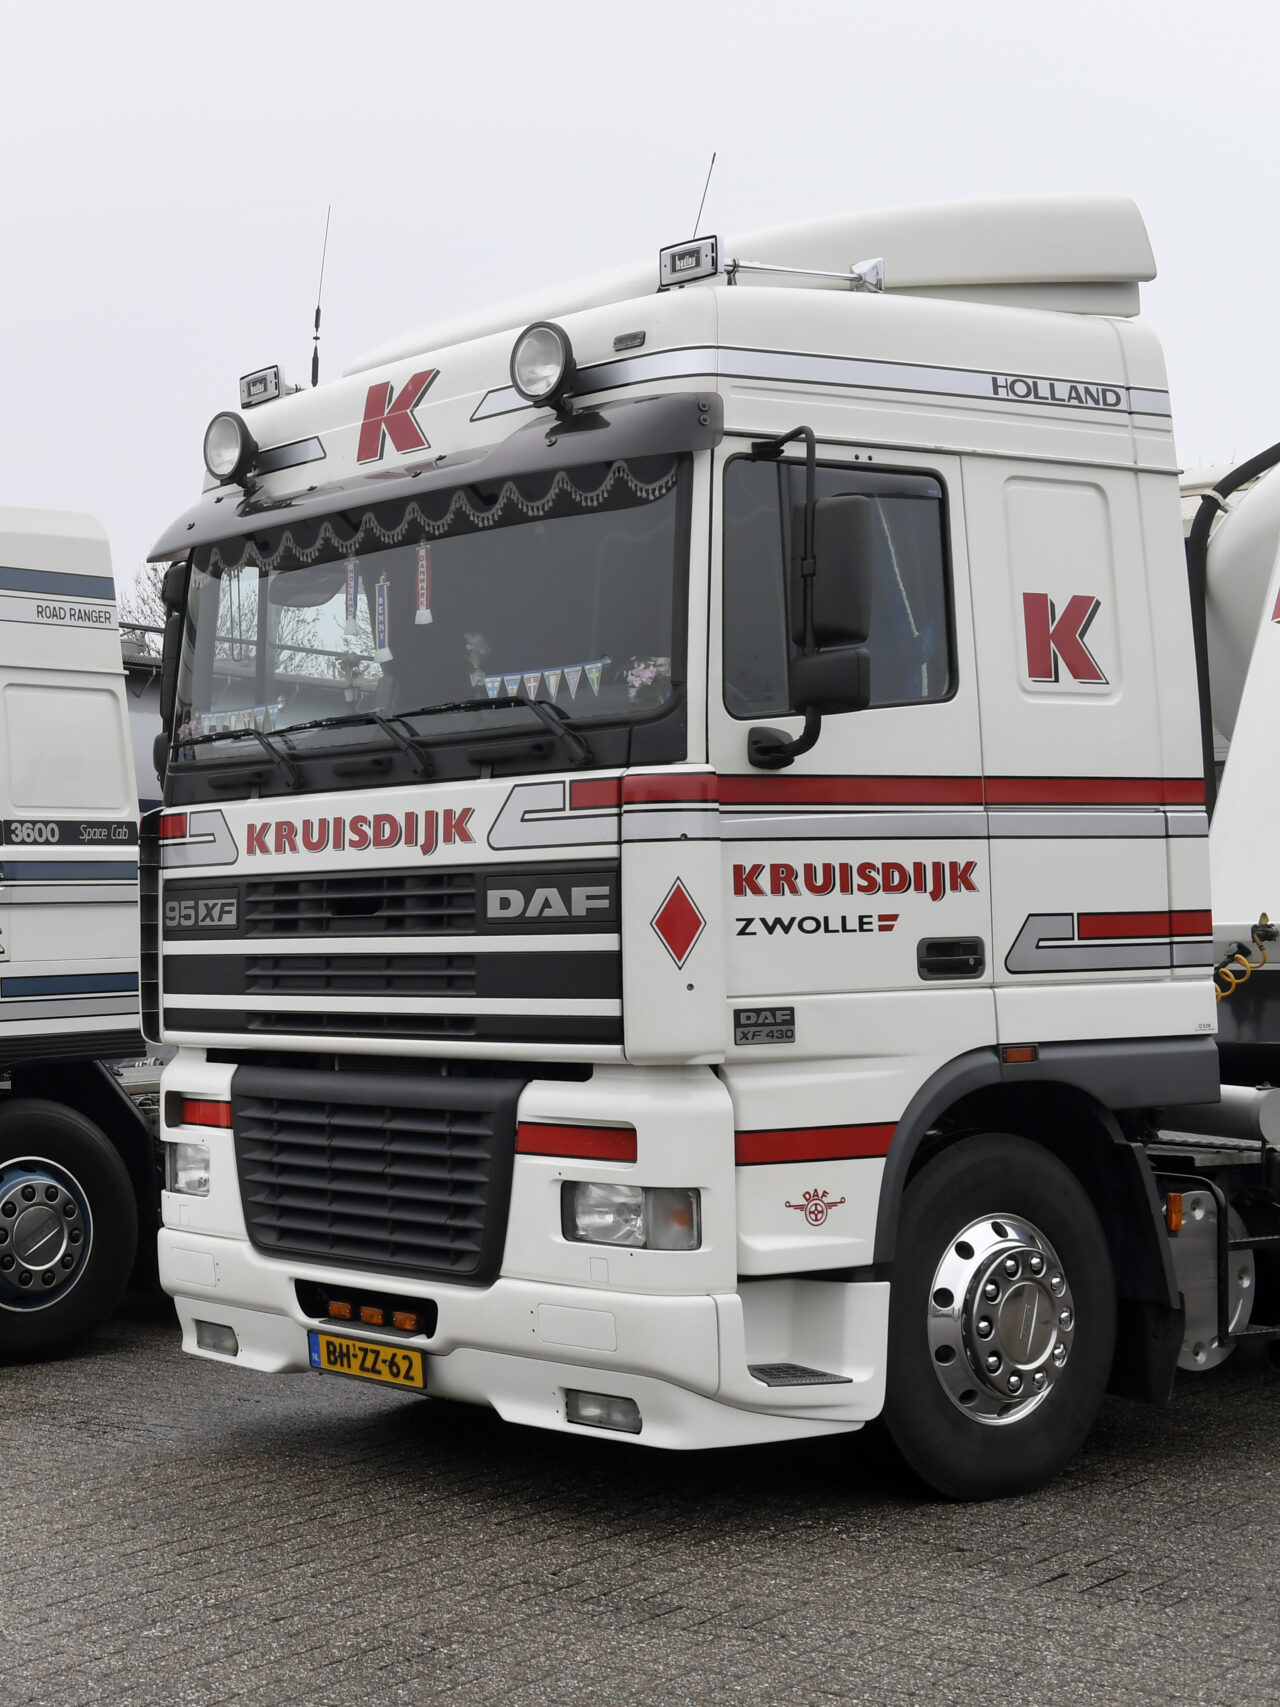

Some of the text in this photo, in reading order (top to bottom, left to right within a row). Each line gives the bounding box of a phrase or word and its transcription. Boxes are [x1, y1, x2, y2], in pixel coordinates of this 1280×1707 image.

[991, 376, 1122, 408] HOLLAND
[356, 368, 441, 465] K
[36, 604, 112, 624] ROAD RANGER
[1022, 592, 1111, 685] K
[10, 822, 129, 844] 3600 Space Cab
[245, 807, 476, 856] KRUISDIJK
[732, 860, 980, 902] KRUISDIJK
[487, 886, 610, 919] DAF
[735, 914, 875, 936] ZWOLLE
[739, 1010, 791, 1025] DAF
[739, 1029, 794, 1041] XF 430
[802, 1188, 830, 1203] DAF
[325, 1340, 416, 1382] BH-ZZ-62
